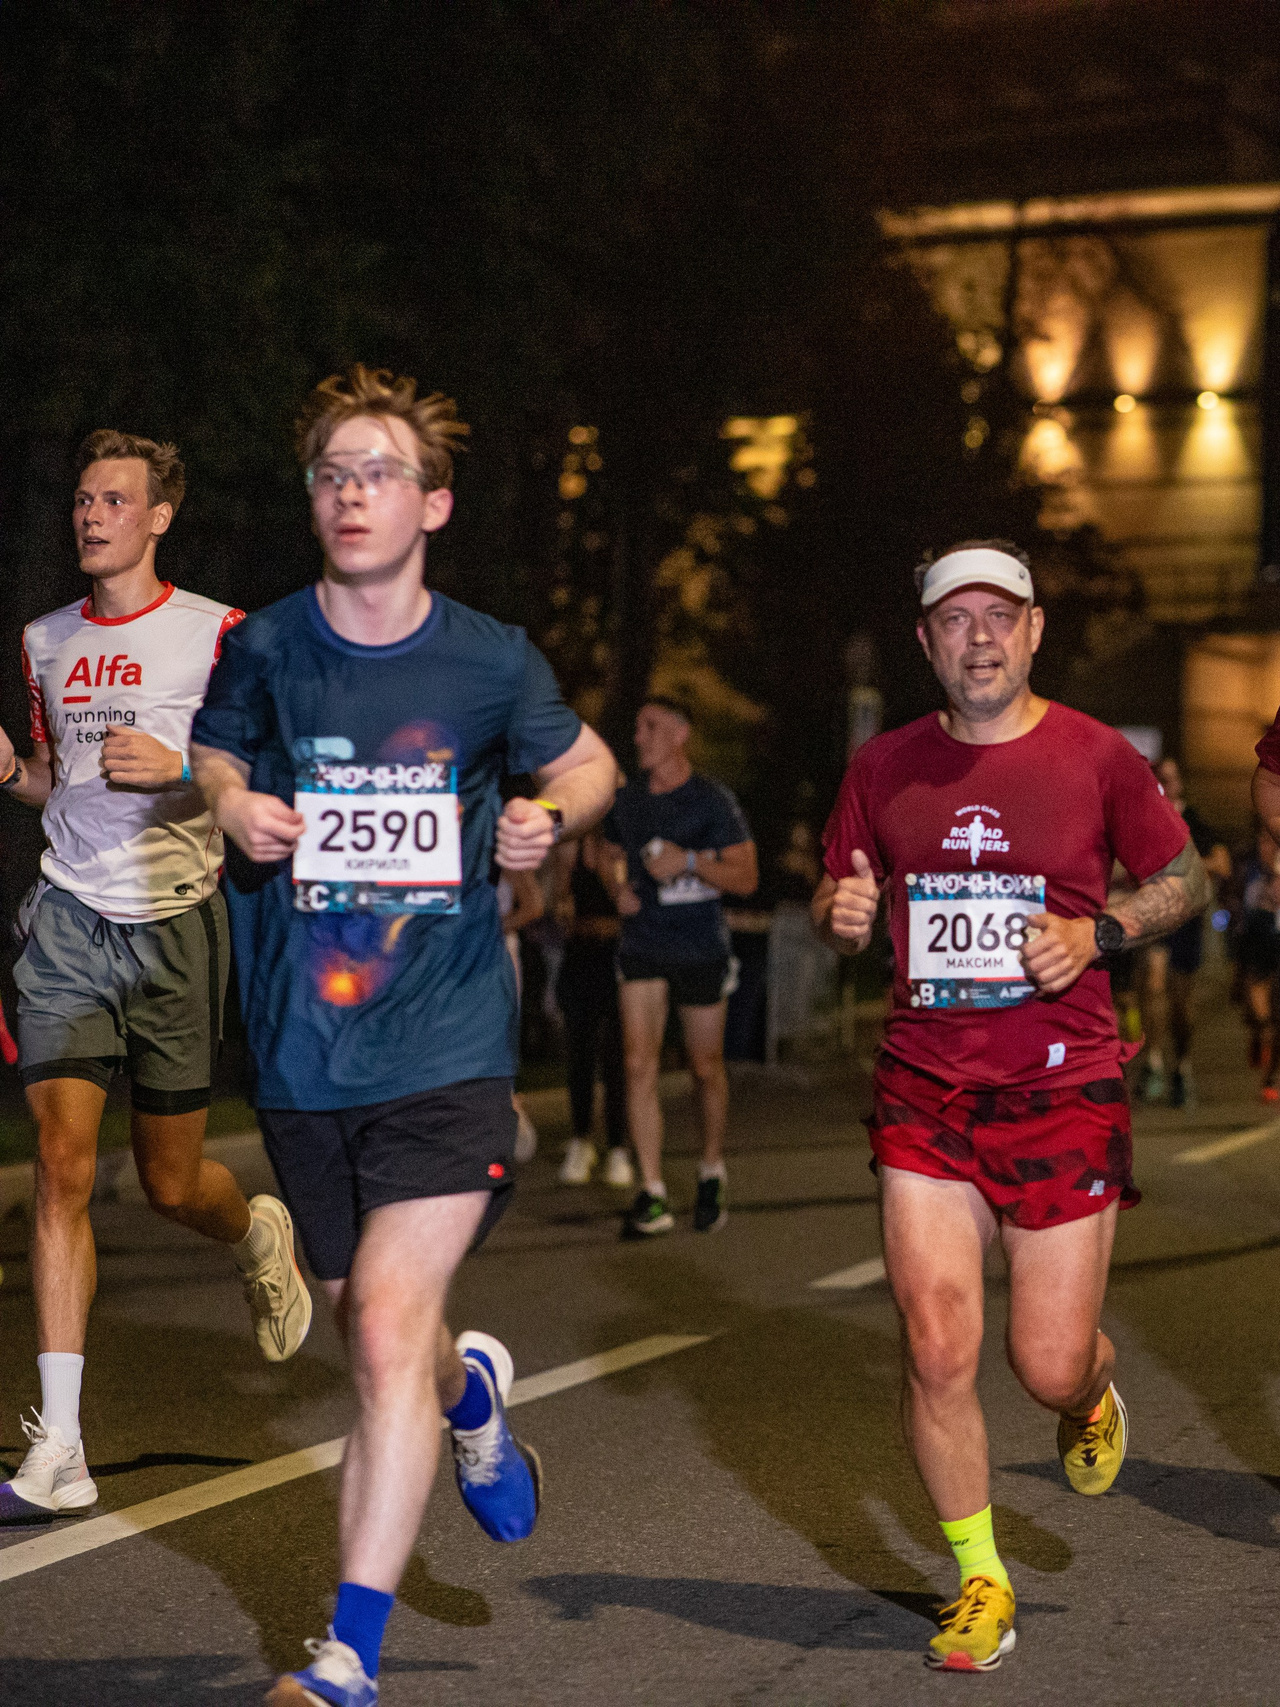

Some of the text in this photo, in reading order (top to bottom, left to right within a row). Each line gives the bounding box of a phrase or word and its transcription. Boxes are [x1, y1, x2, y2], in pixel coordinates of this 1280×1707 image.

[64, 654, 142, 688] Alfa
[65, 706, 136, 726] running
[76, 729, 109, 743] tea
[318, 809, 438, 853] 2590
[950, 826, 1003, 840] ROAD
[942, 838, 1010, 852] RUNNERS
[927, 912, 1029, 952] 2068
[946, 957, 1004, 969] МАКСИМ
